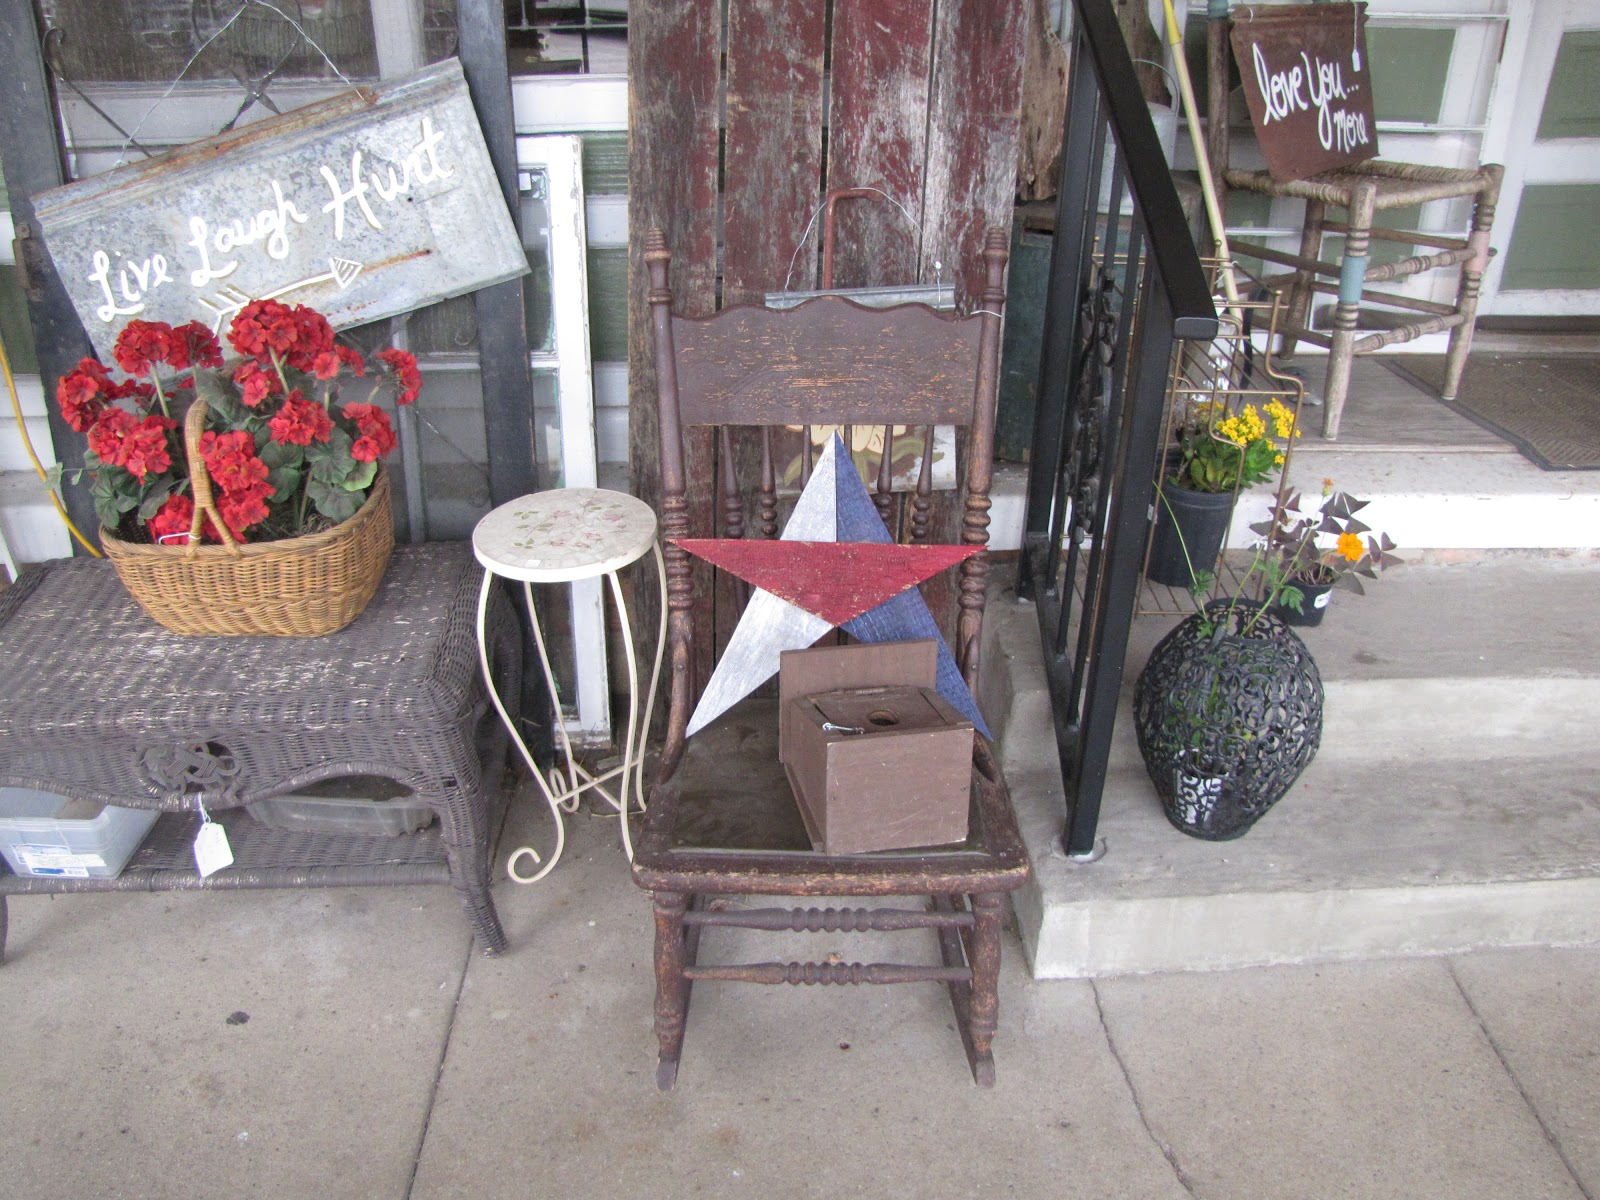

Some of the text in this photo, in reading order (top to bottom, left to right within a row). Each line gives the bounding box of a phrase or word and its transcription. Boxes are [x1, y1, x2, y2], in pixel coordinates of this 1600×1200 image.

[88, 117, 454, 322] Live Laugh Hunt
